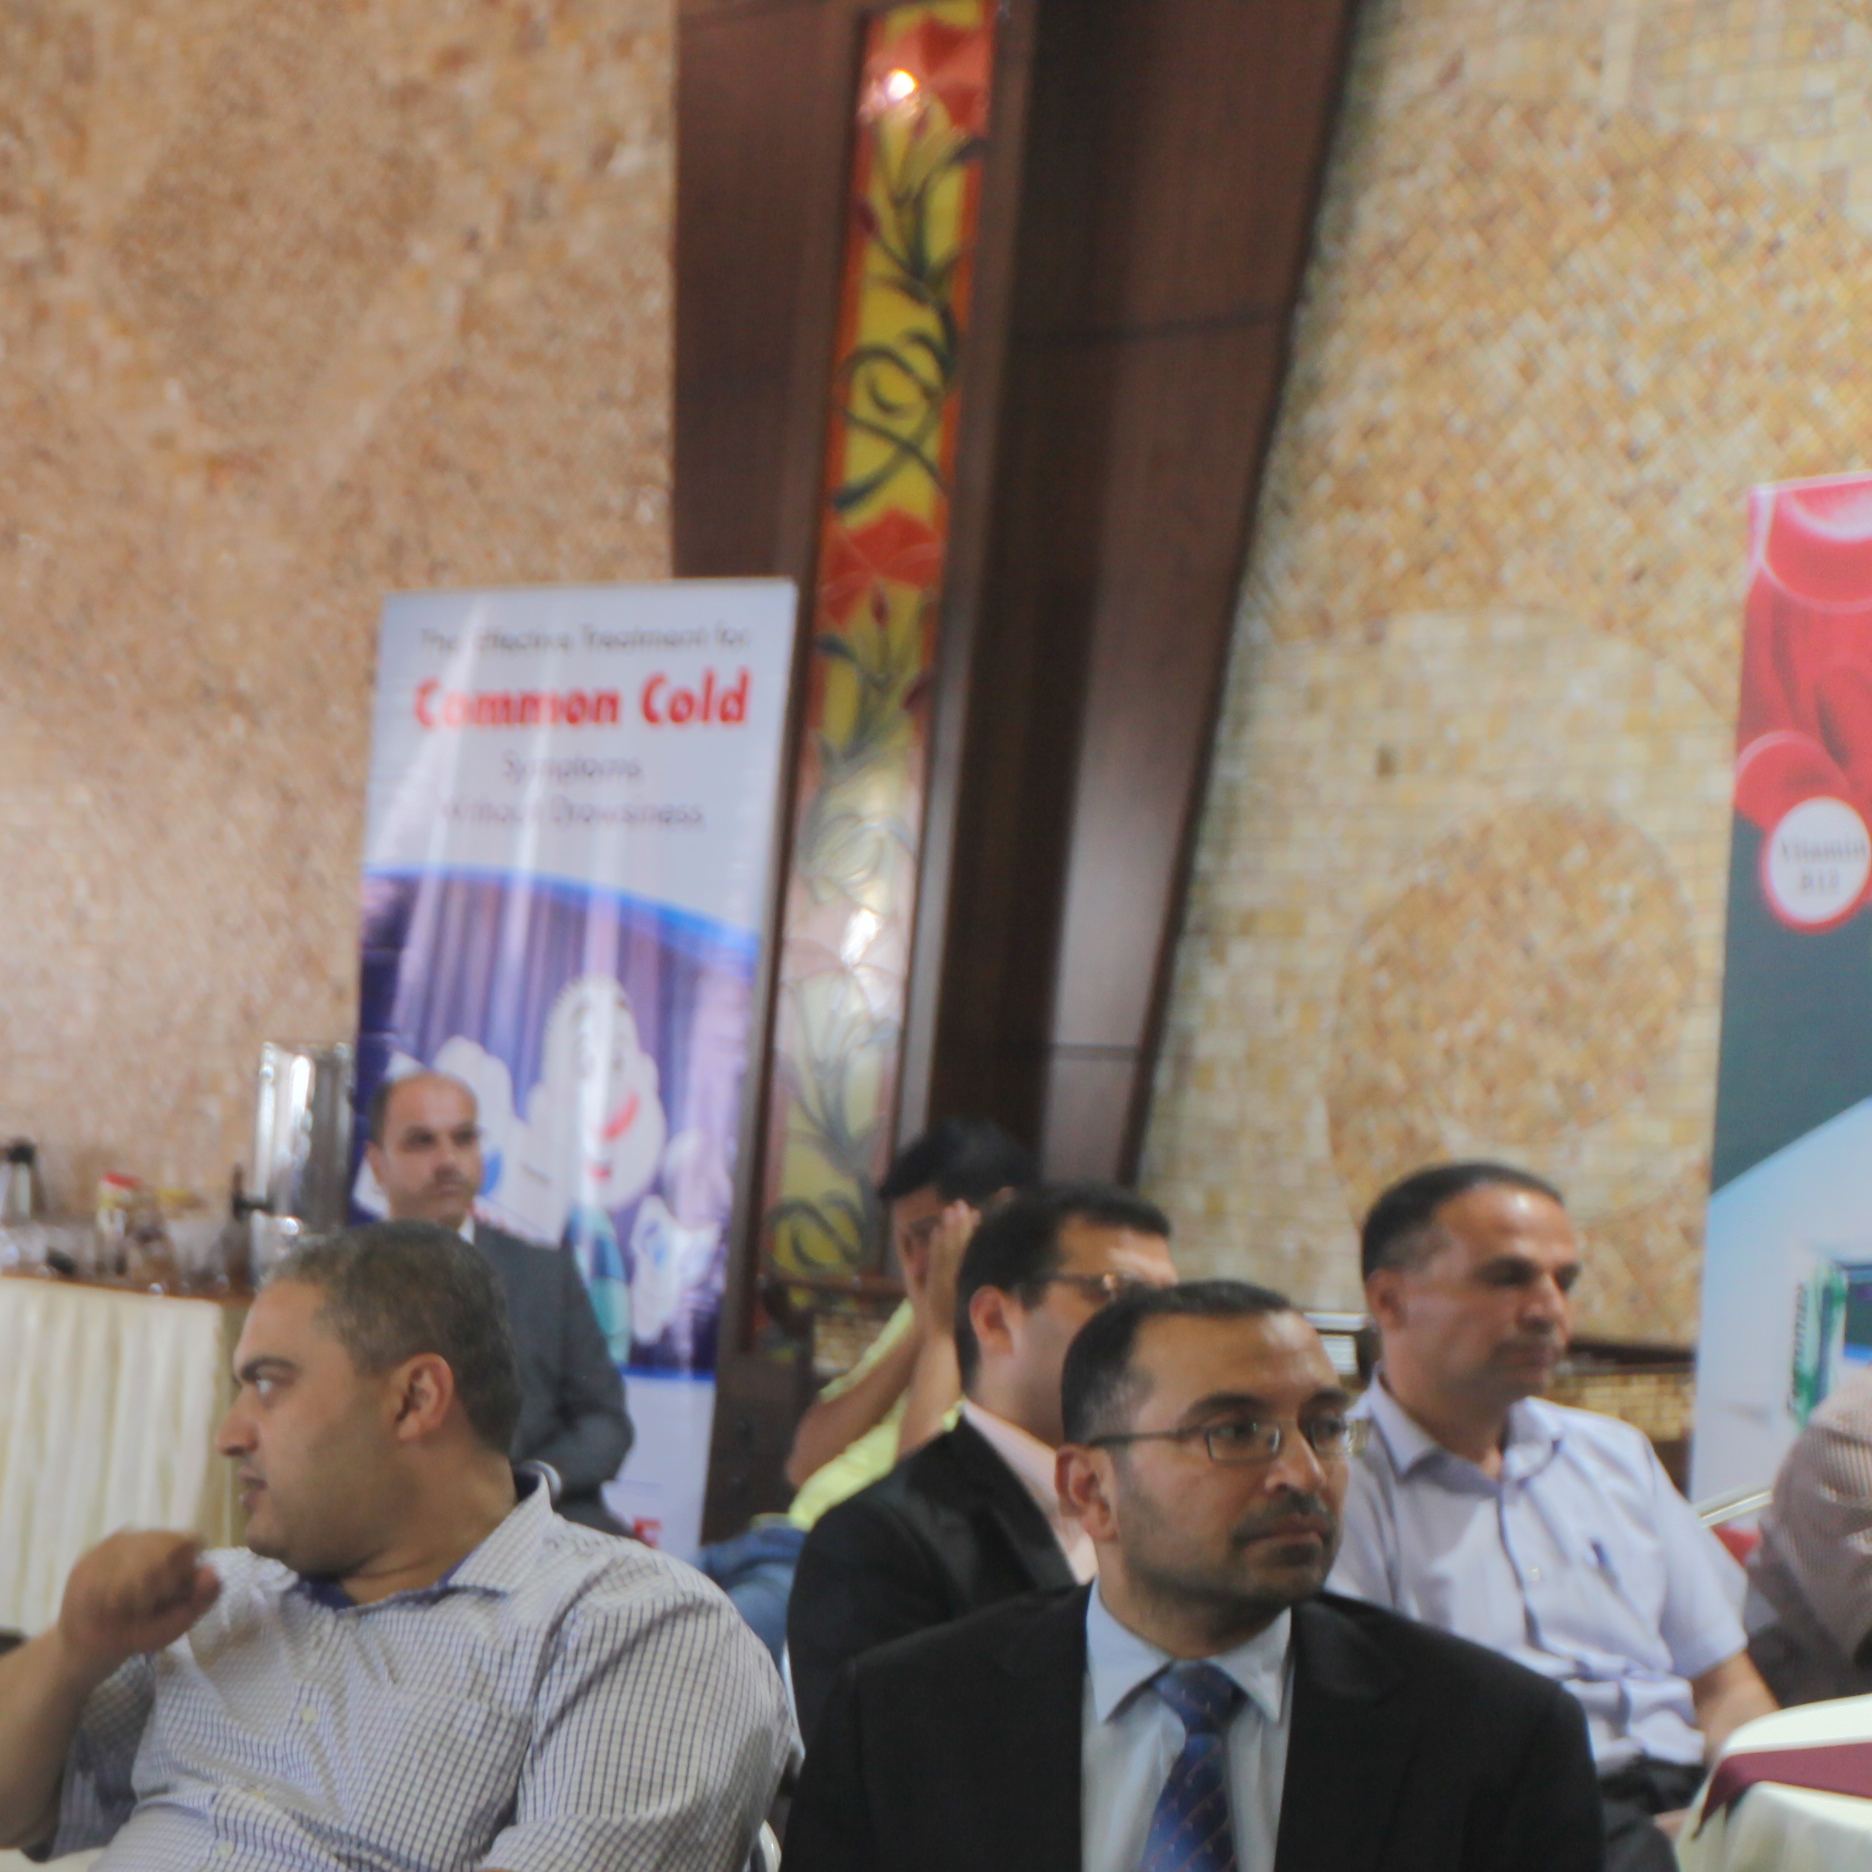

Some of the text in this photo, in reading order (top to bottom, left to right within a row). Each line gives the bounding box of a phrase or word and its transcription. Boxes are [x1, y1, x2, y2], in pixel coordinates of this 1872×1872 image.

[420, 627, 457, 653] The
[581, 621, 707, 651] Treatment
[717, 619, 750, 647] for
[414, 667, 751, 728] Common Cold
[1779, 836, 1866, 861] Vitamin
